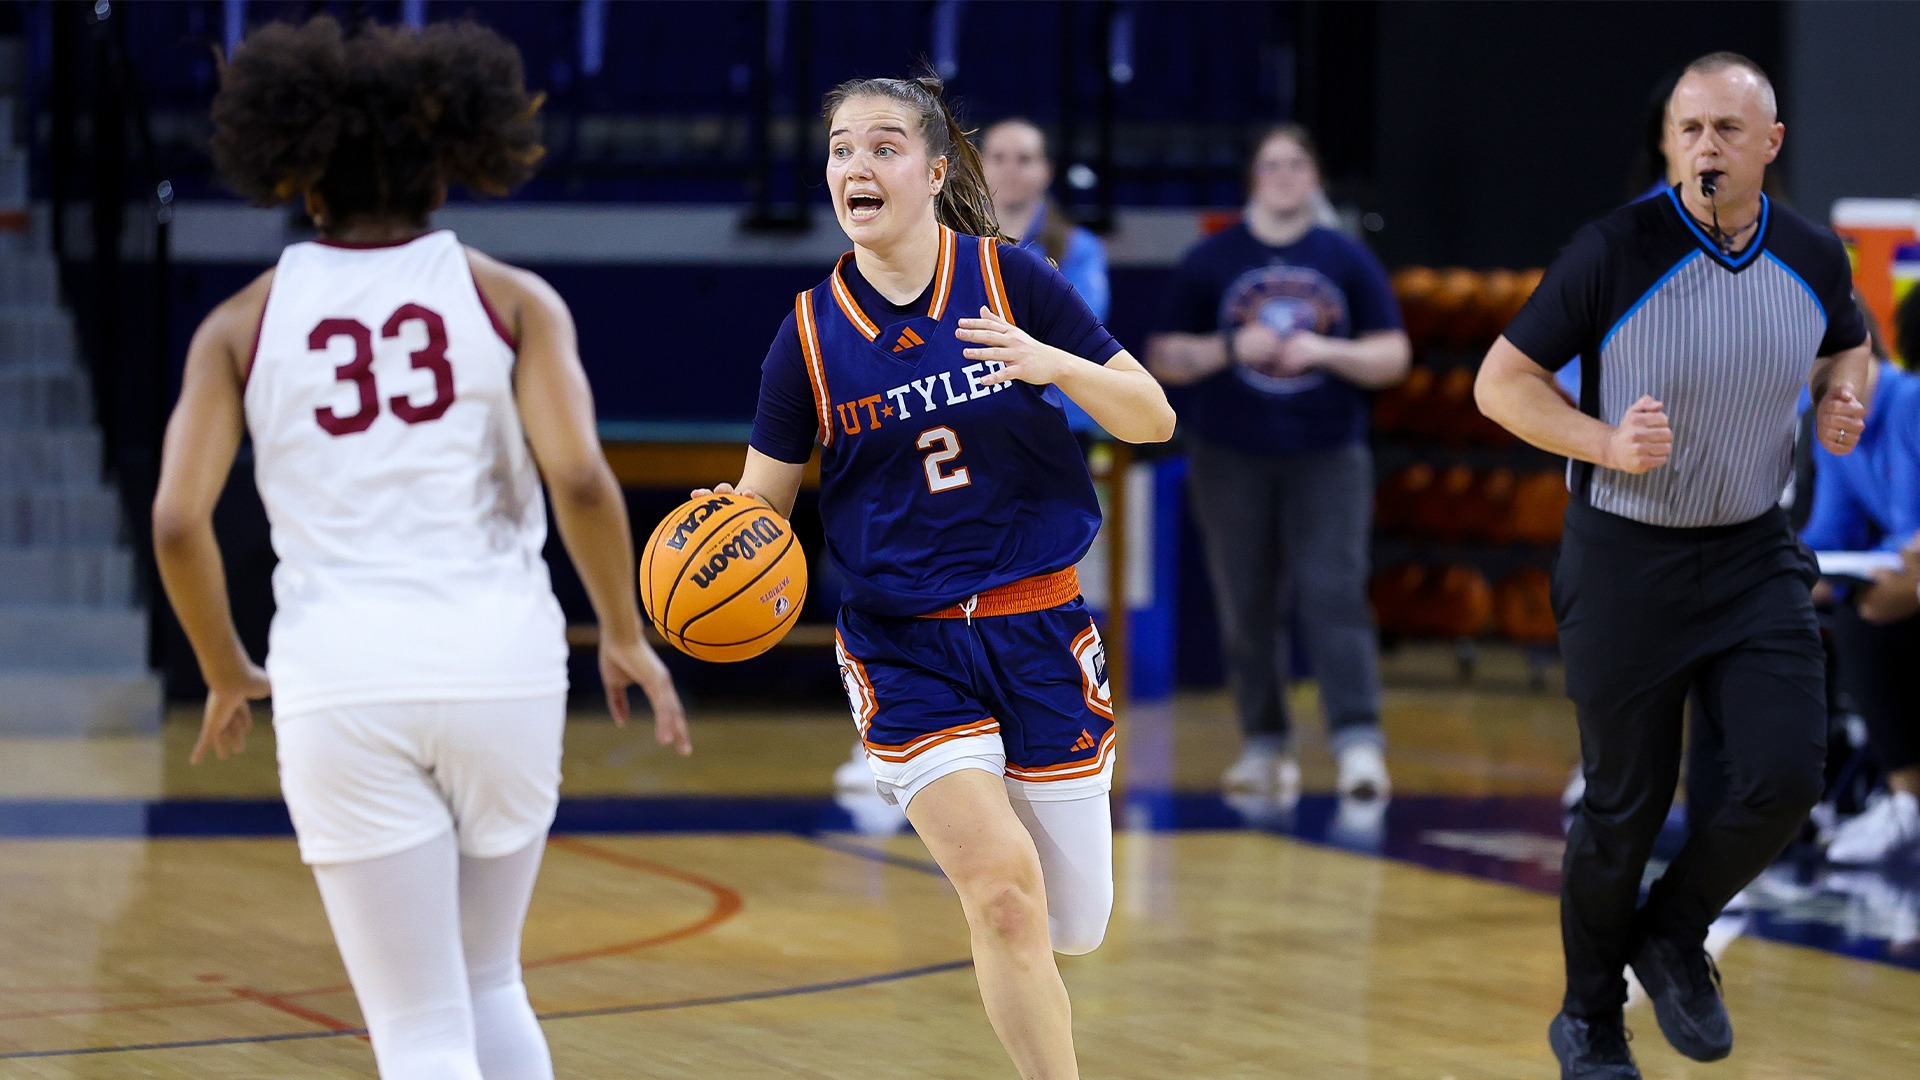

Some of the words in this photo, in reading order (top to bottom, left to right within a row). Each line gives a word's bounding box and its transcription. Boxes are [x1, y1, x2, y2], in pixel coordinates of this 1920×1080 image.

[308, 303, 455, 436] 33
[837, 394, 882, 435] UT
[915, 424, 971, 494] 2
[666, 497, 734, 551] NCAA
[690, 516, 784, 588] Wilson
[759, 576, 790, 603] PATRIOTS
